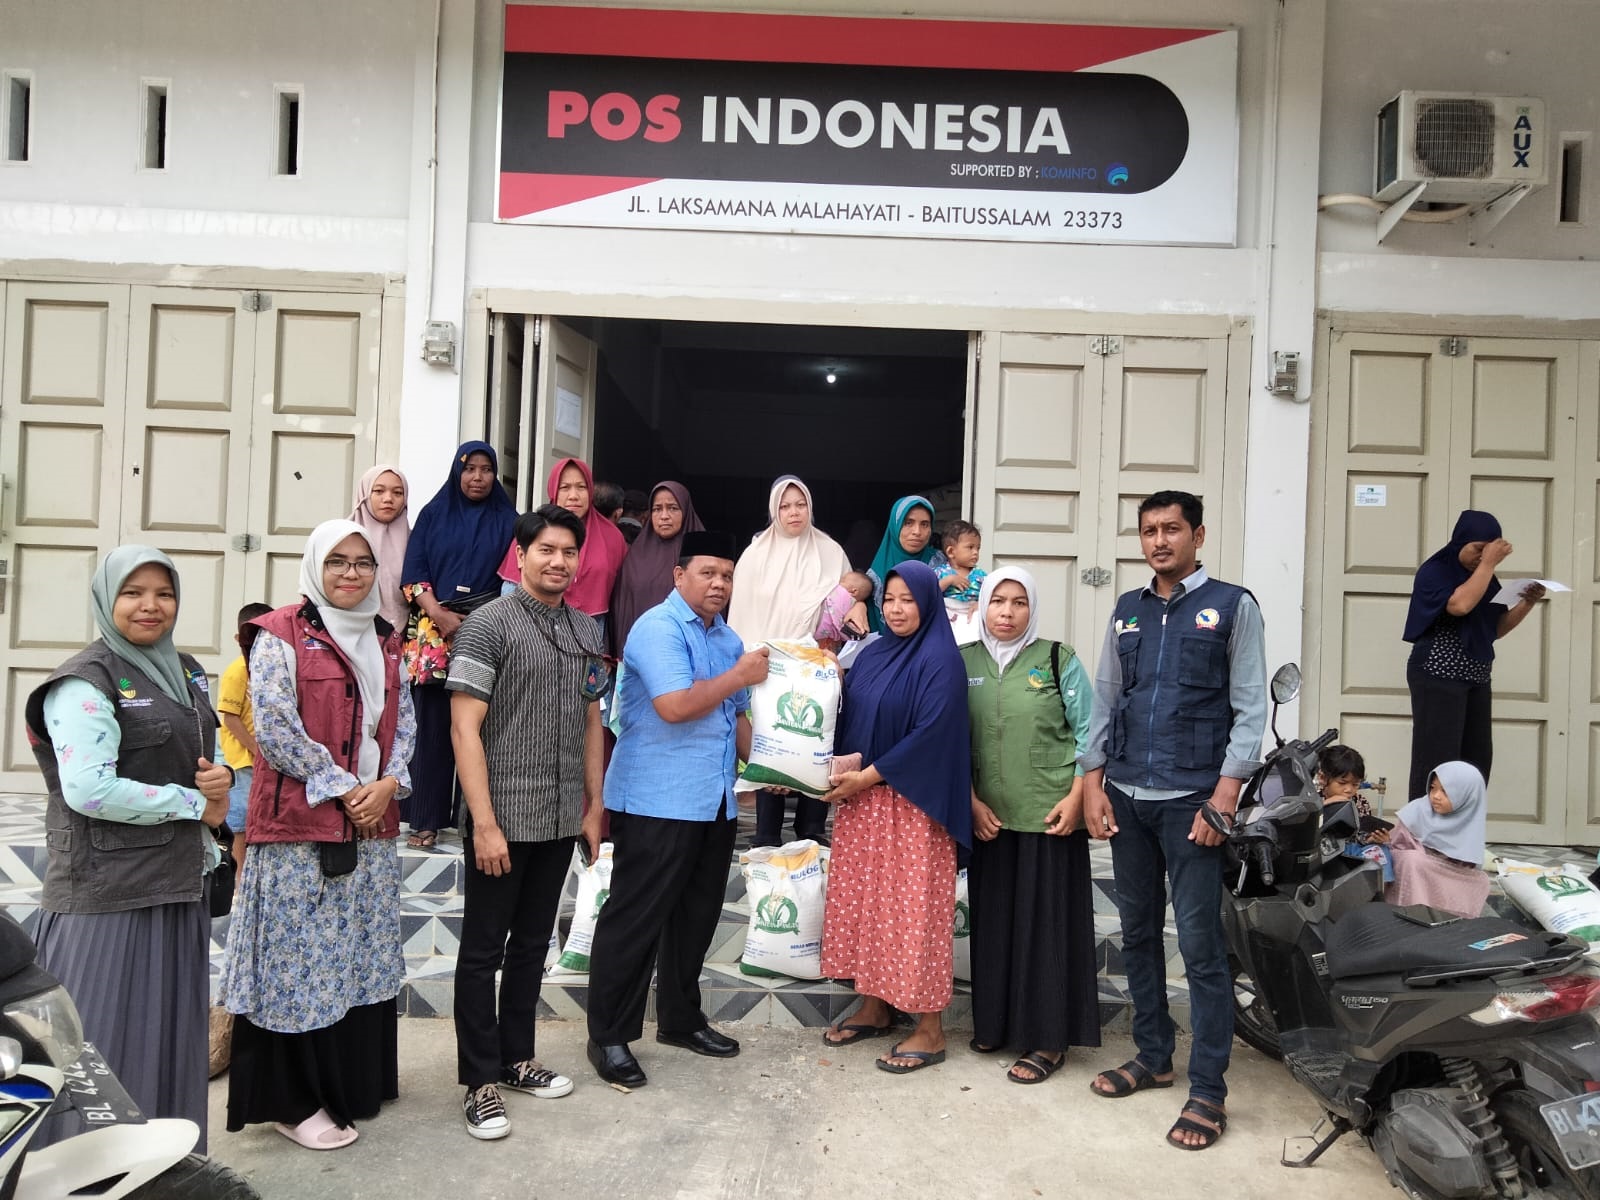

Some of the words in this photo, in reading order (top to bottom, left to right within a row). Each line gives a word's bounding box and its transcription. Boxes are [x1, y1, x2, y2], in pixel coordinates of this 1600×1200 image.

[547, 90, 681, 143] POS
[701, 95, 1072, 155] INDONESIA
[1512, 115, 1533, 168] AUX
[949, 163, 1015, 178] SUPPORTED
[1017, 166, 1033, 178] BY
[1041, 166, 1097, 181] KOMINFO
[628, 196, 651, 214] JL.
[656, 197, 776, 219] LAKSAMANA
[781, 202, 901, 223] MALAHAYATI
[922, 206, 1052, 226] BAITUSSALAM
[1063, 210, 1123, 229] 23373
[83, 1102, 117, 1121] BL
